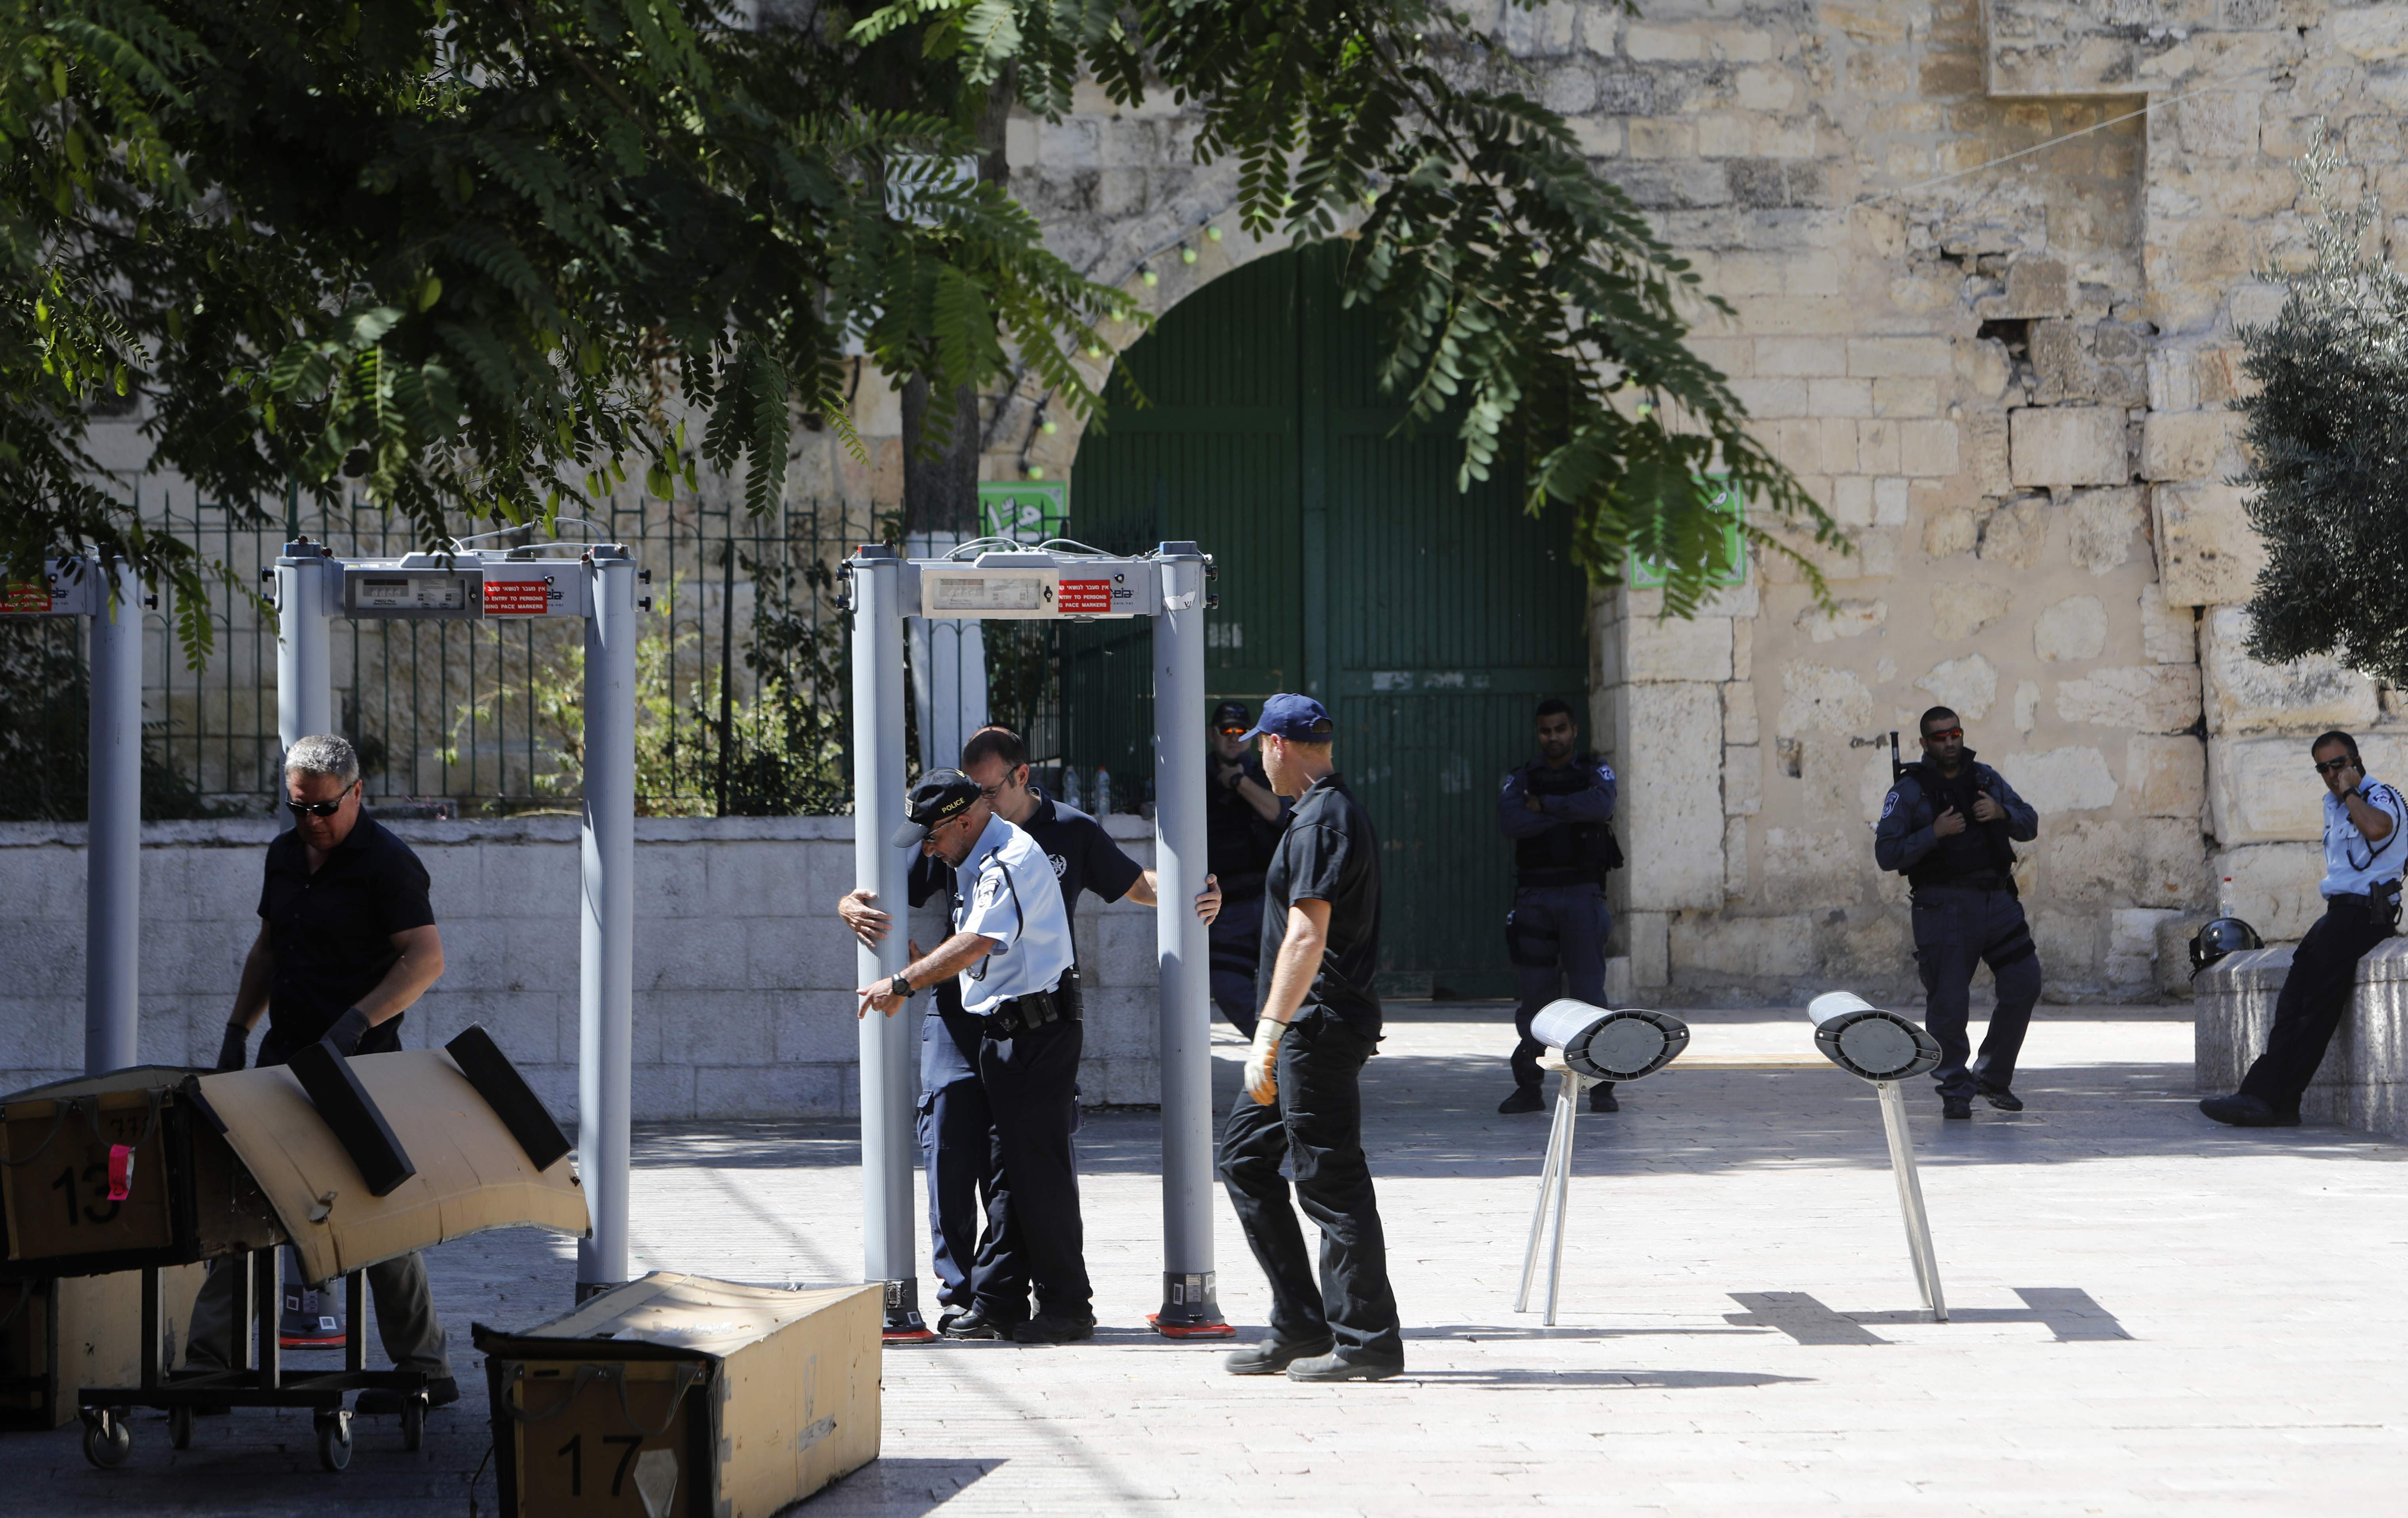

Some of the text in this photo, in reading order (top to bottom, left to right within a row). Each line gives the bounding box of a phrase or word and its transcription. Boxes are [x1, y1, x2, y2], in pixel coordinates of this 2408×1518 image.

[942, 797, 965, 813] POLICE
[53, 1162, 121, 1225] 13
[558, 1434, 643, 1497] 17
